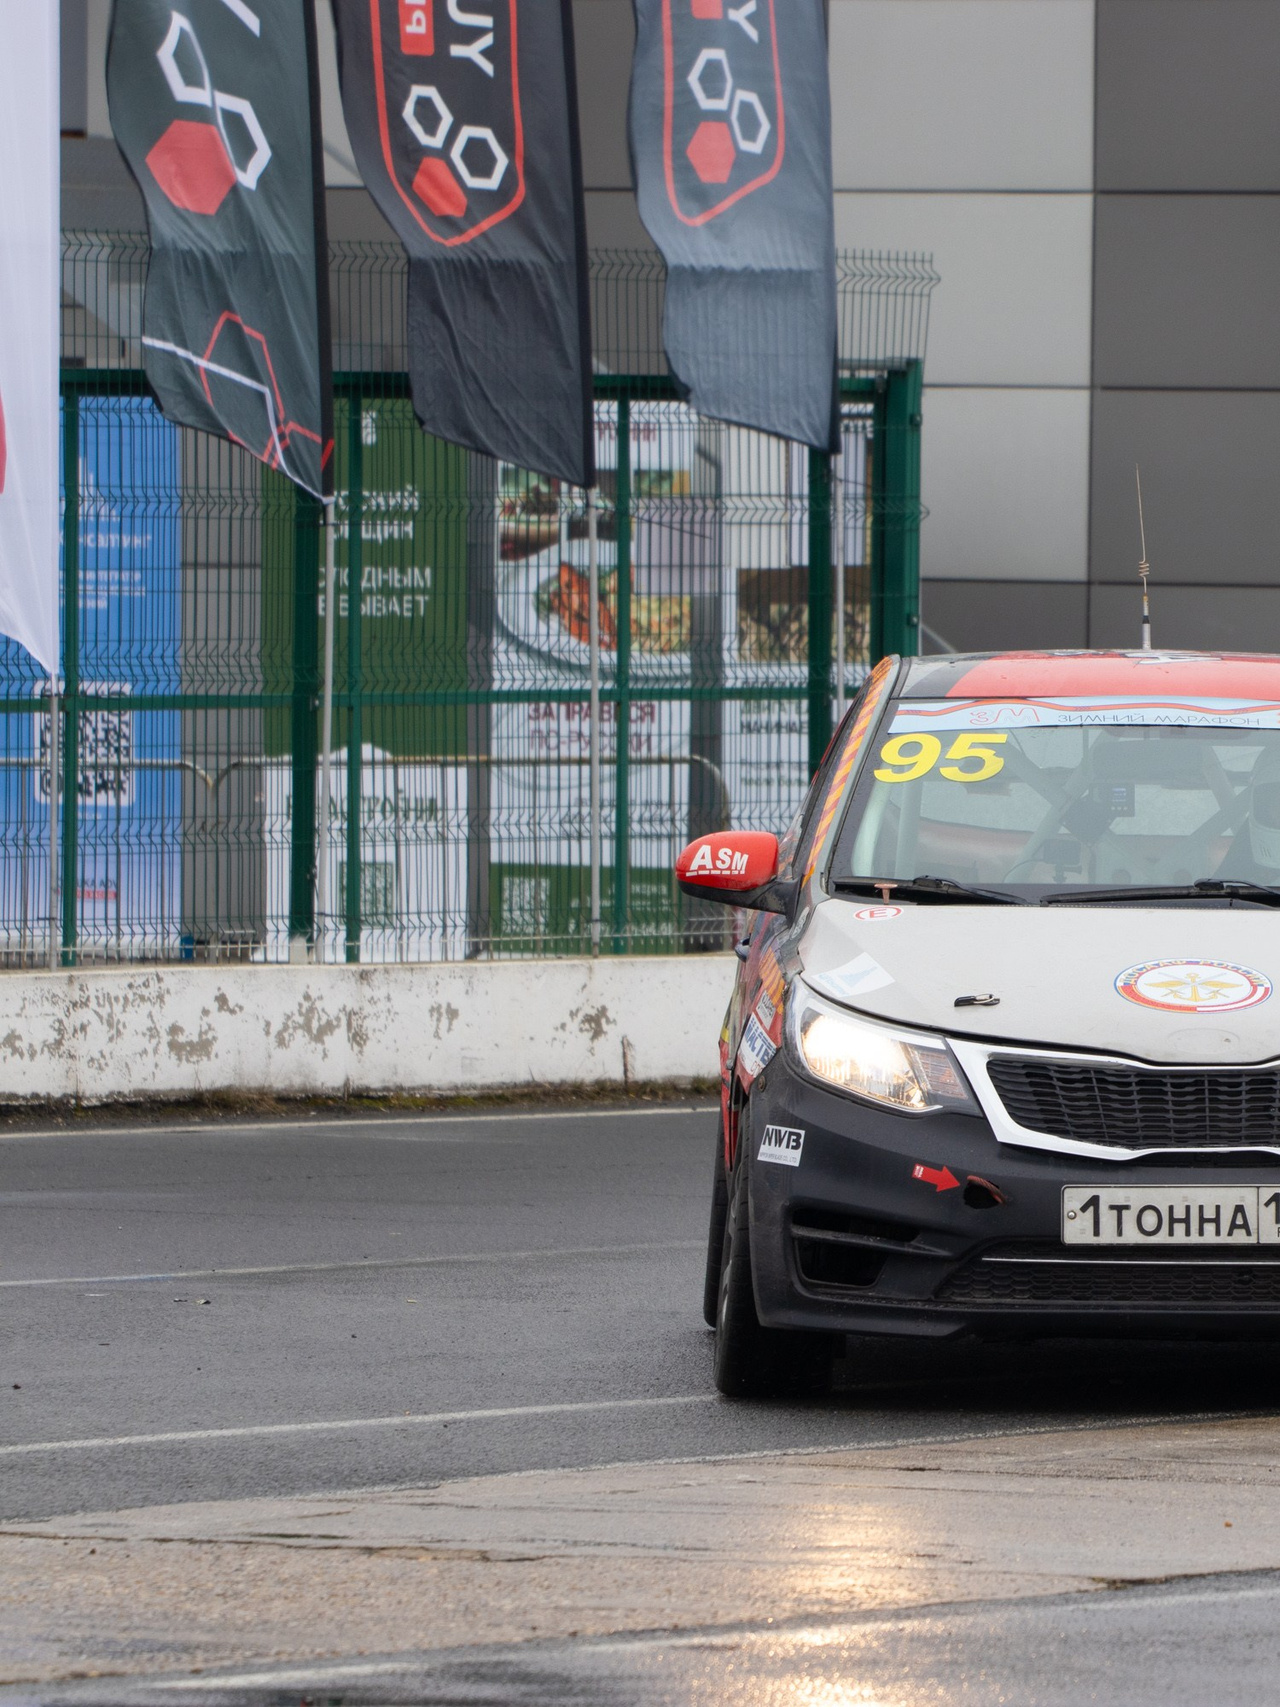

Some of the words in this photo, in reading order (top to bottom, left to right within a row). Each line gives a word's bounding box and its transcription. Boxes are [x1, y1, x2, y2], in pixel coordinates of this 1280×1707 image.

[528, 701, 656, 723] ЗАПРАВСЯ
[1057, 713, 1145, 723] ЗИМНИЙ
[1154, 713, 1260, 727] МАРАФОН
[873, 733, 1008, 783] 95
[689, 844, 749, 875] ASM
